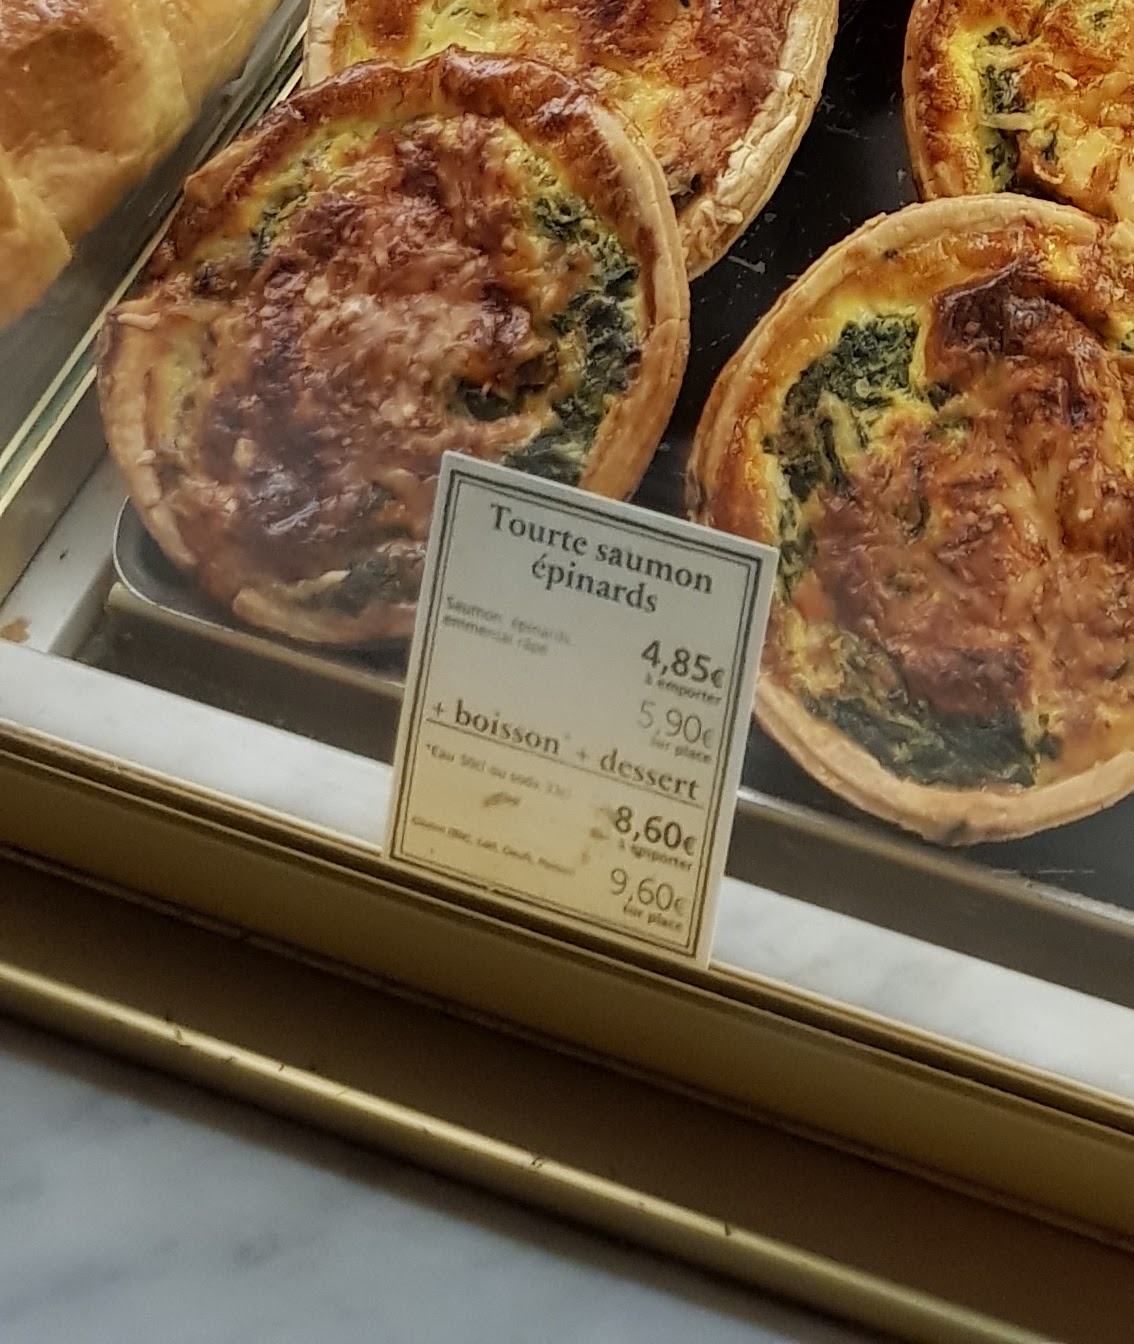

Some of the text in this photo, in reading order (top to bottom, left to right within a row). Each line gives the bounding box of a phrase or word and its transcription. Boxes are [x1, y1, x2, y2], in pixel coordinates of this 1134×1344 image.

[490, 503, 714, 595] Tourte saumon
[531, 553, 659, 614] épinards
[641, 639, 726, 690] 4,85€
[599, 748, 700, 802] dessert
[615, 805, 698, 856] 8,60€
[610, 867, 687, 917] 9,60€
